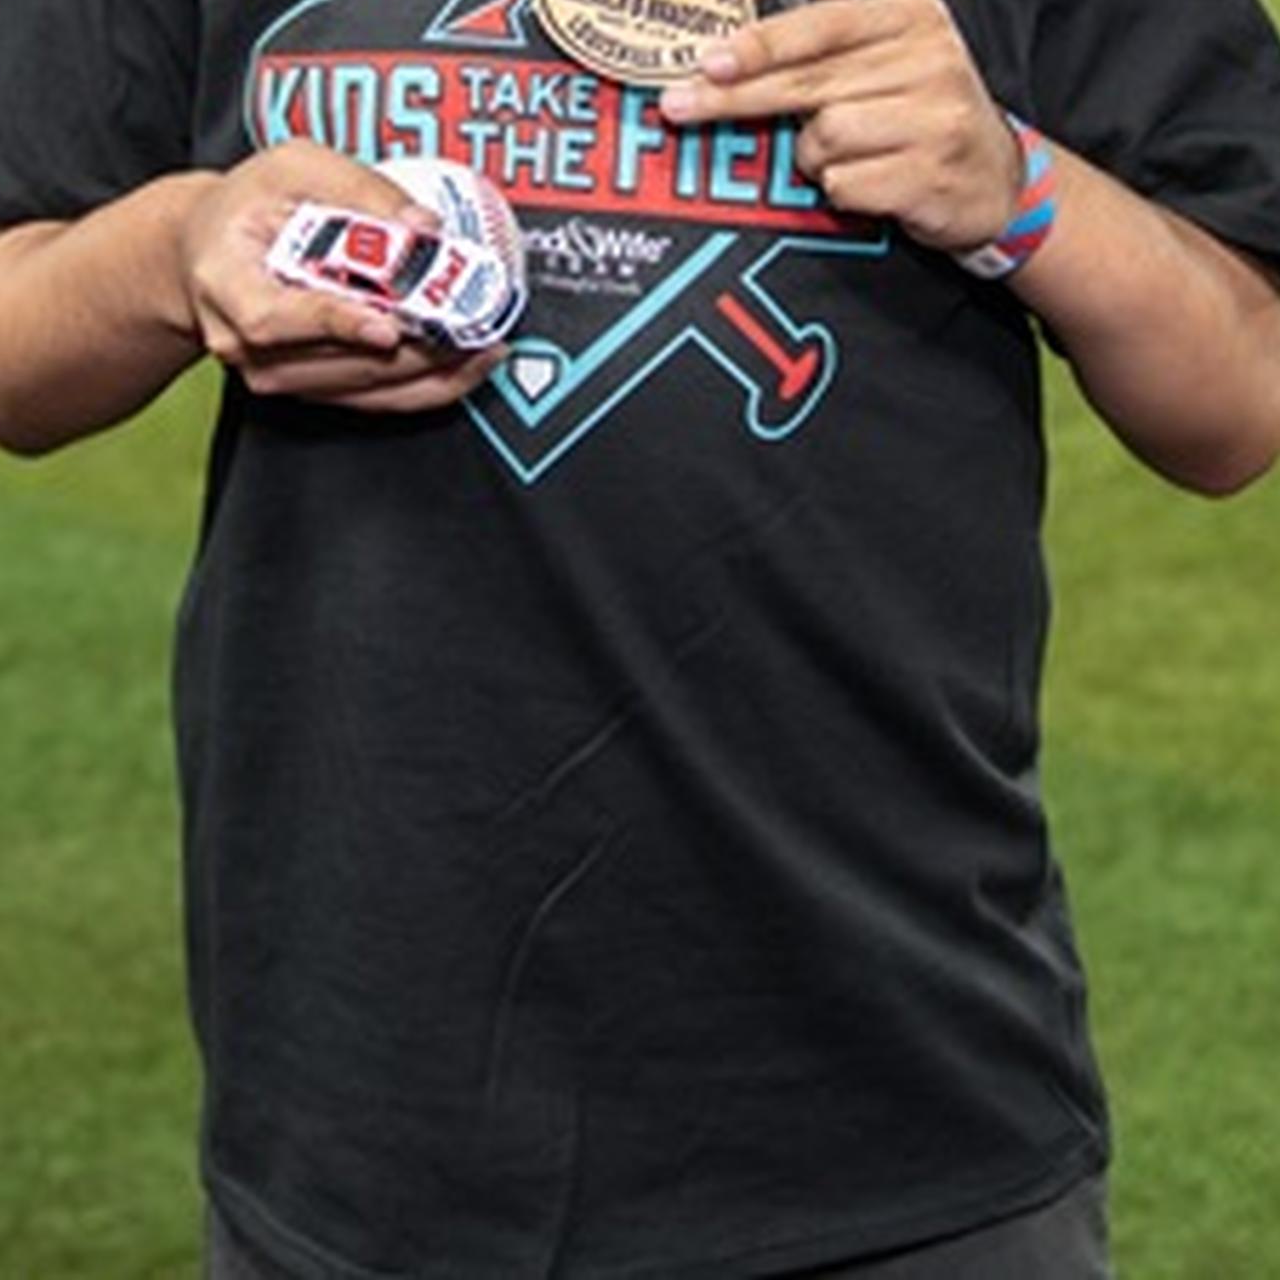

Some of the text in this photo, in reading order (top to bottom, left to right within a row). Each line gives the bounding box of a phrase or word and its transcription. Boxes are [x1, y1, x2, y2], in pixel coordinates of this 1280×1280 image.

[259, 63, 820, 210] KIDS TAKE THE FIEL
